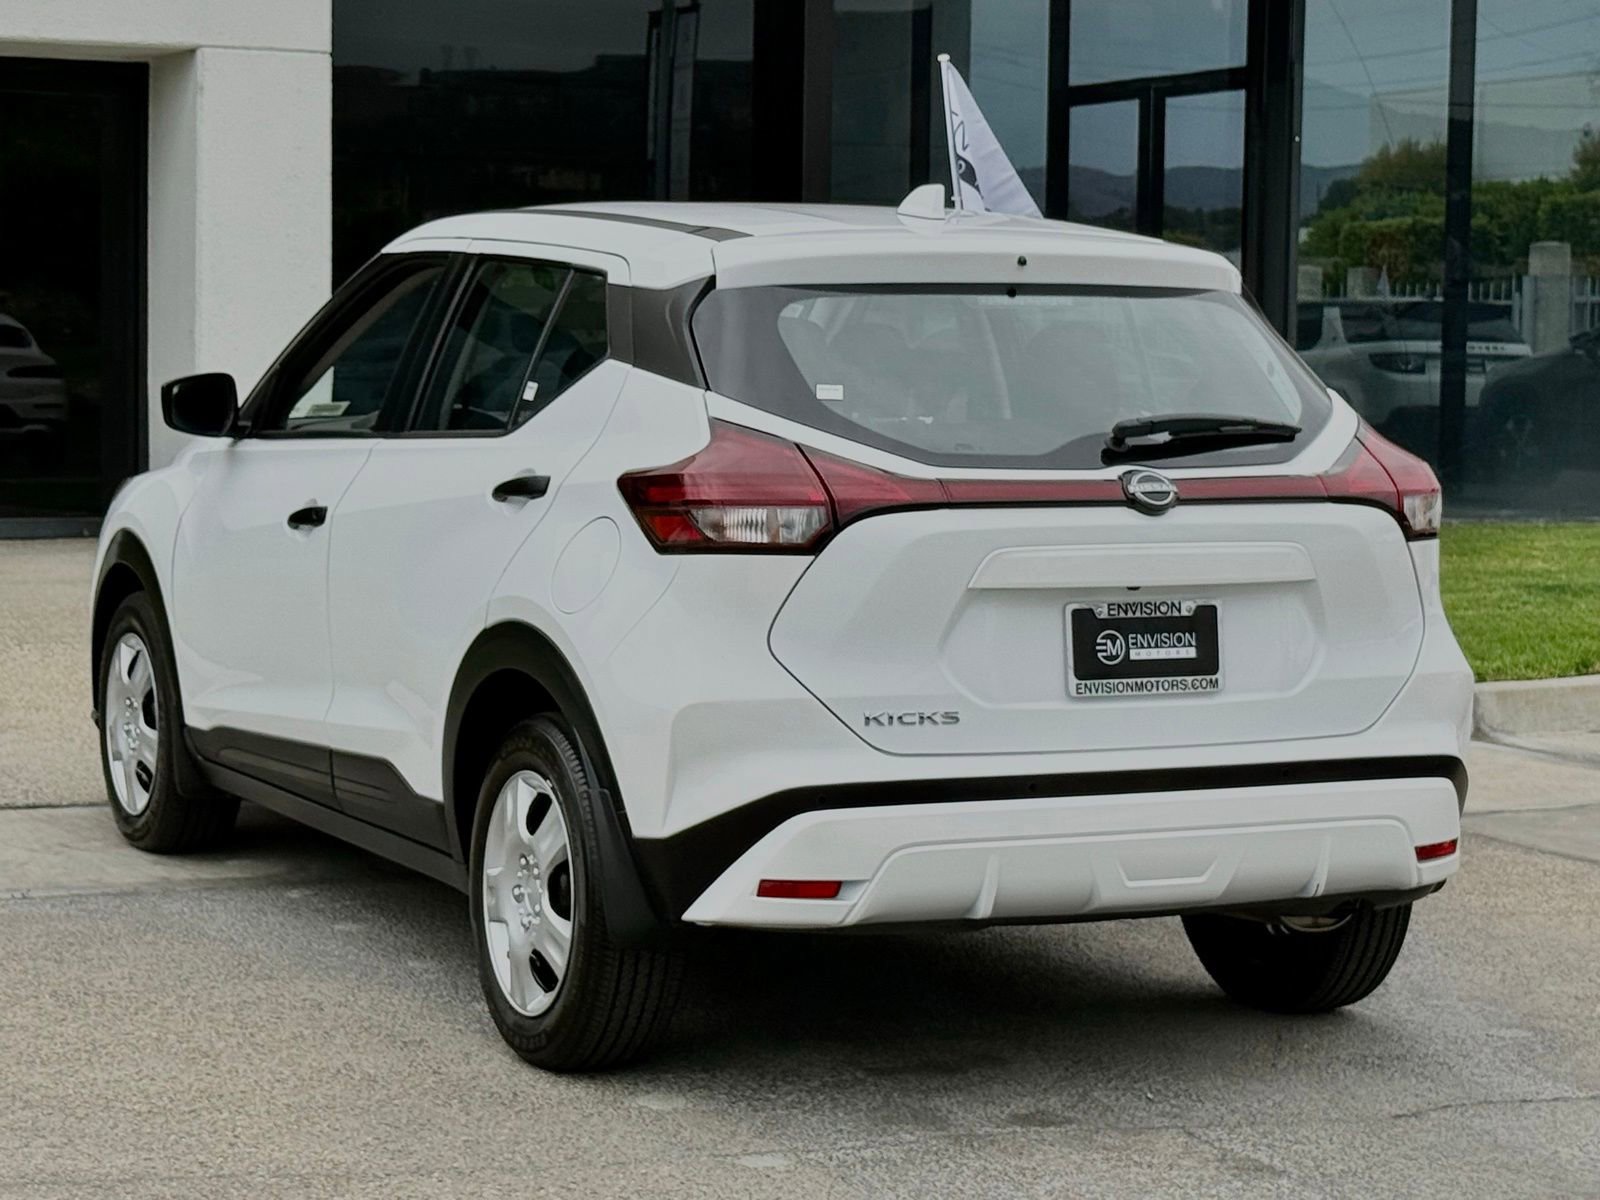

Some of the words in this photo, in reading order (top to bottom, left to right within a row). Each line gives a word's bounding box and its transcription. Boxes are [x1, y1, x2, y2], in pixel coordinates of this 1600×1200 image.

[1107, 601, 1182, 617] ENVISION
[1128, 632, 1197, 648] ENVISION
[1075, 678, 1219, 695] ENVISIONMOTORS.COM
[863, 711, 960, 727] KICKS
